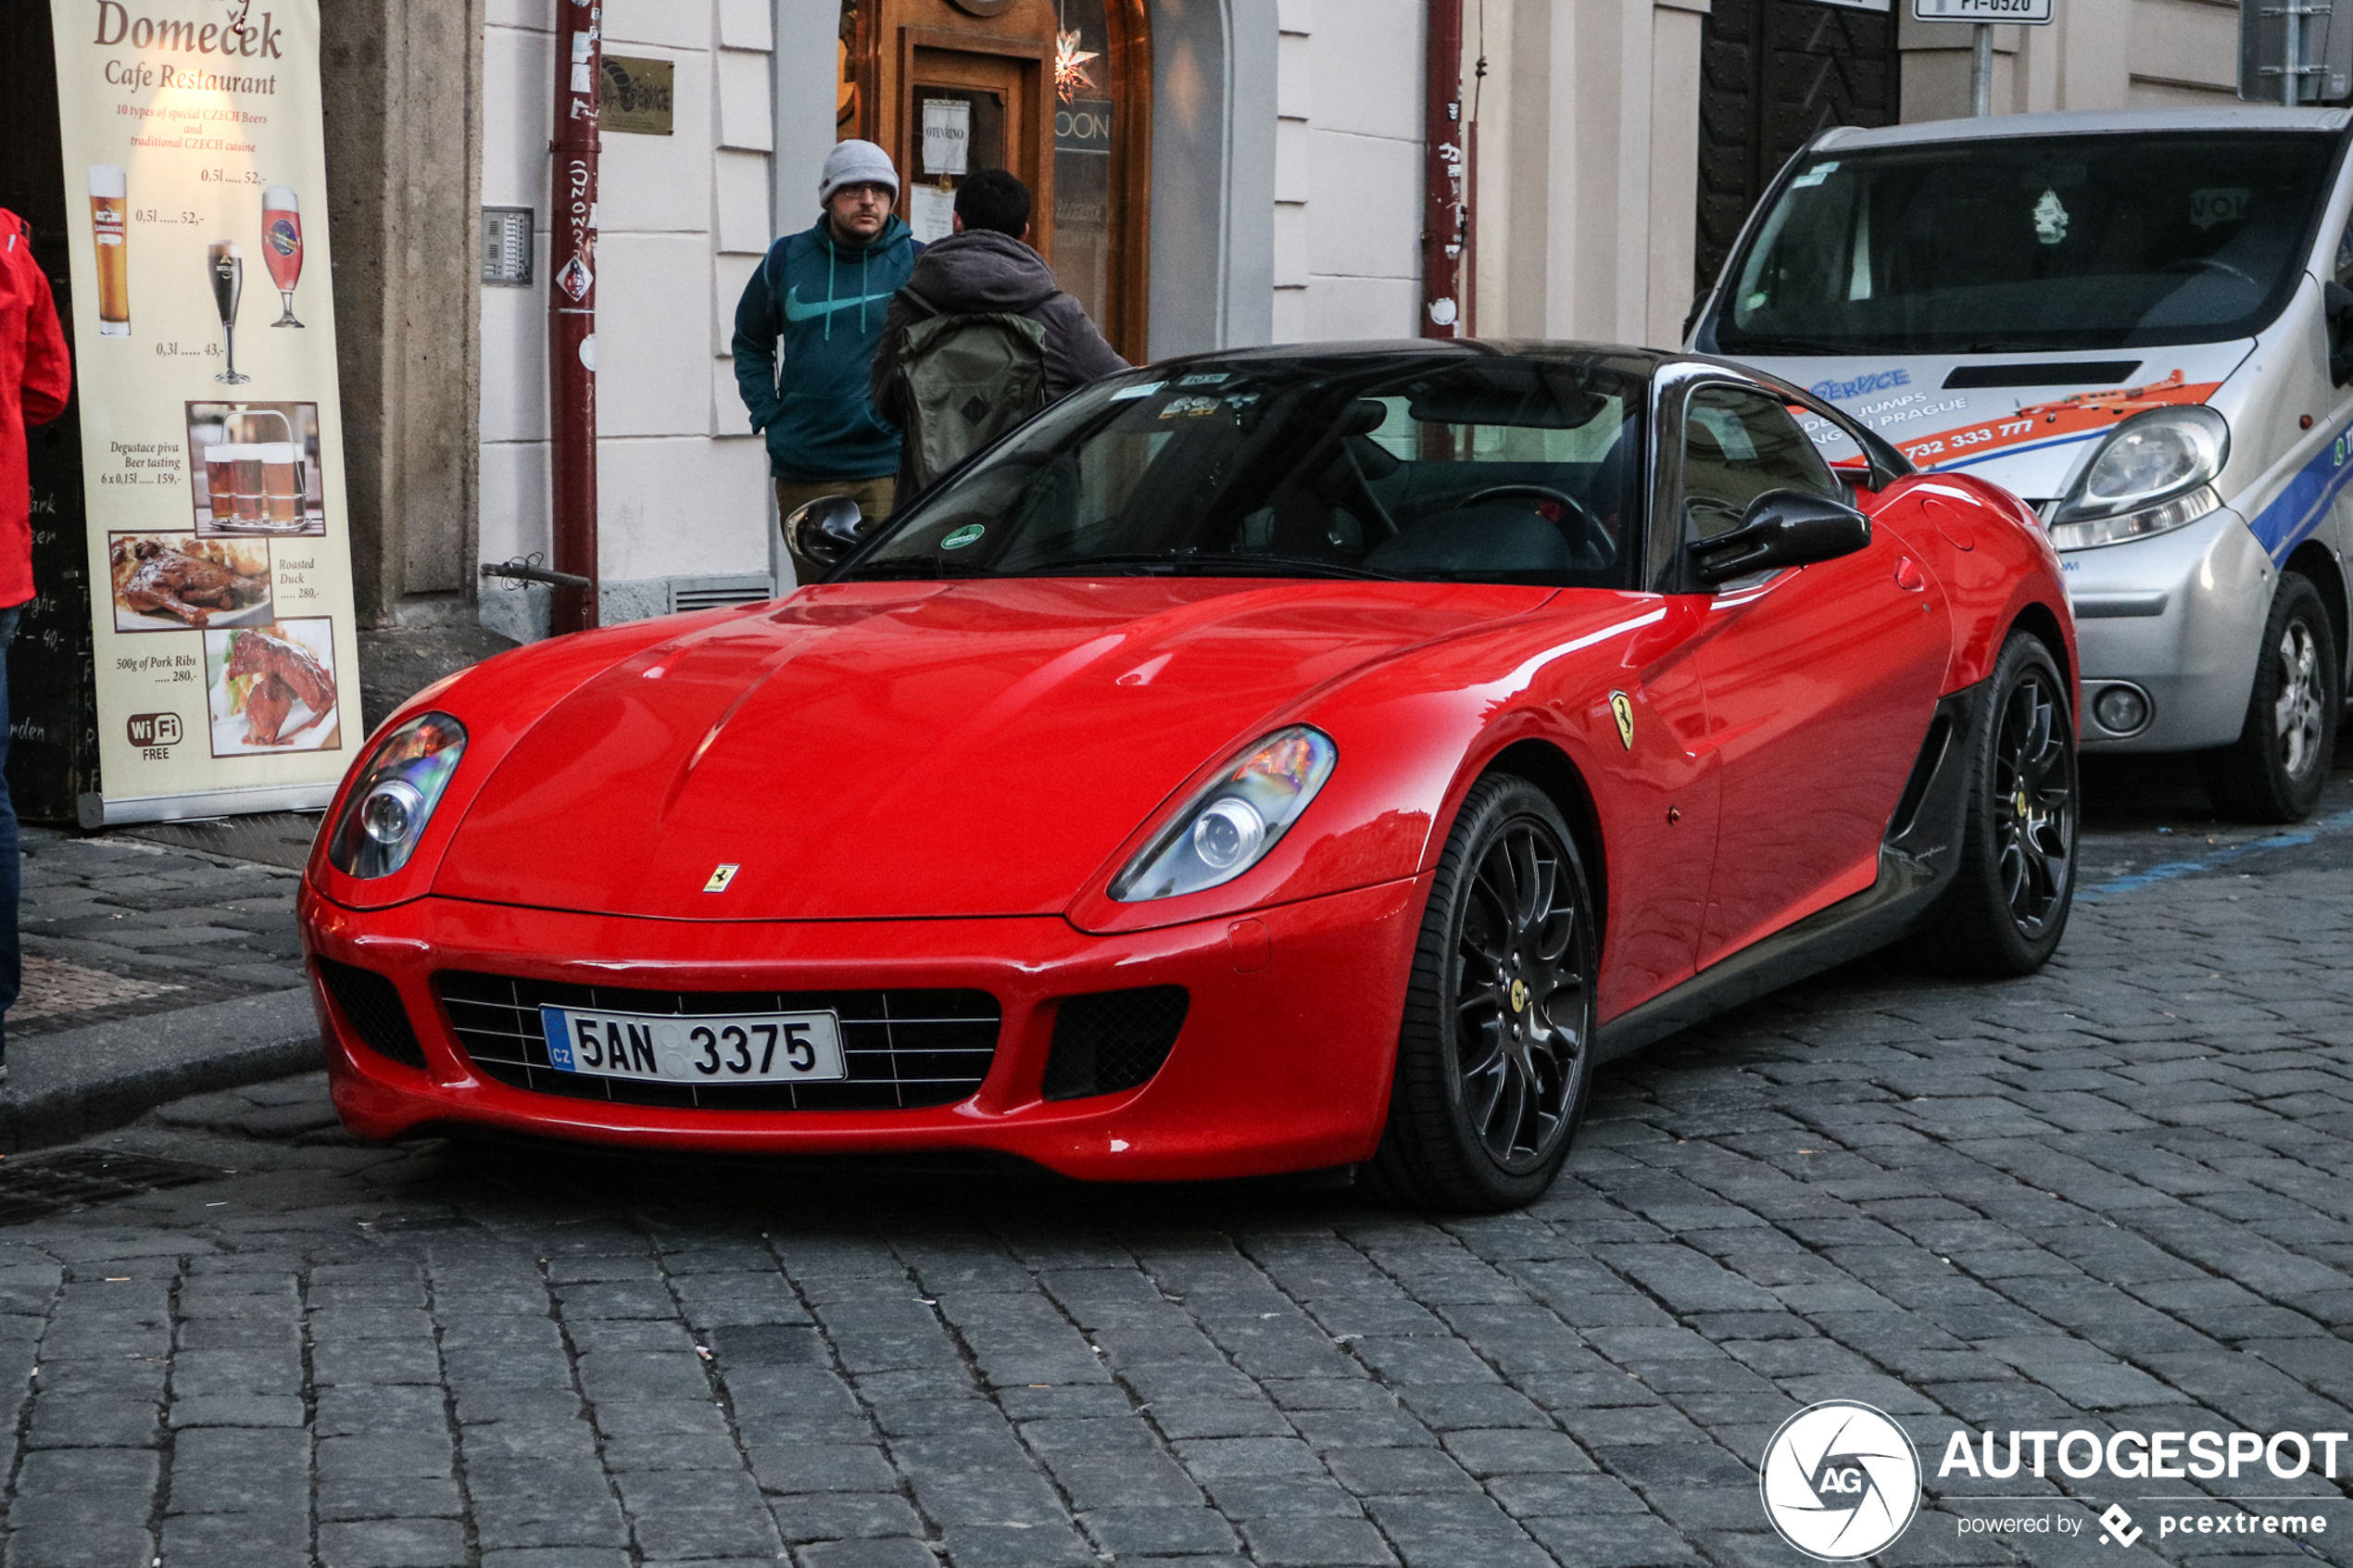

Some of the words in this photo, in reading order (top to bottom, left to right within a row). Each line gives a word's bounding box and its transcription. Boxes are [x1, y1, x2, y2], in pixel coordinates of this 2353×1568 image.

[94, 0, 282, 59] Domeček
[105, 60, 153, 94] Cafe
[159, 64, 276, 94] Restaurant
[117, 104, 128, 115] 10
[130, 106, 155, 119] types
[157, 107, 167, 120] of
[169, 107, 200, 121] special
[203, 109, 240, 122] CZECH
[242, 112, 268, 124] Beers
[183, 124, 203, 134] and
[131, 135, 182, 149] traditional
[184, 138, 223, 150] CZECH
[225, 141, 256, 153] cuisine
[244, 171, 267, 185] 52,-
[181, 211, 204, 226] 52,-
[204, 343, 224, 358] 43,-
[1809, 369, 1911, 402] SERVICE
[1857, 392, 1927, 418] JUMPS
[1881, 397, 1968, 427] PRAGUE
[1905, 440, 1944, 461] 732
[1950, 428, 1993, 448] 333
[1997, 419, 2033, 438] 777
[111, 441, 155, 456] Degustace
[157, 442, 179, 456] piva
[125, 457, 145, 468] Beer
[147, 457, 181, 470] tasting
[101, 472, 107, 484] 6
[108, 475, 114, 484] x
[157, 473, 181, 485] 159,-
[279, 558, 314, 570] Roasted
[280, 572, 304, 584] Duck
[298, 587, 320, 599] 280,-
[116, 658, 137, 671] 500g
[139, 657, 149, 671] of
[150, 656, 172, 668] Pork
[175, 655, 196, 667] Ribs
[172, 671, 197, 683] 280,-
[143, 747, 170, 760] FREE
[552, 1047, 572, 1064] CZ
[689, 1022, 816, 1075] 3375
